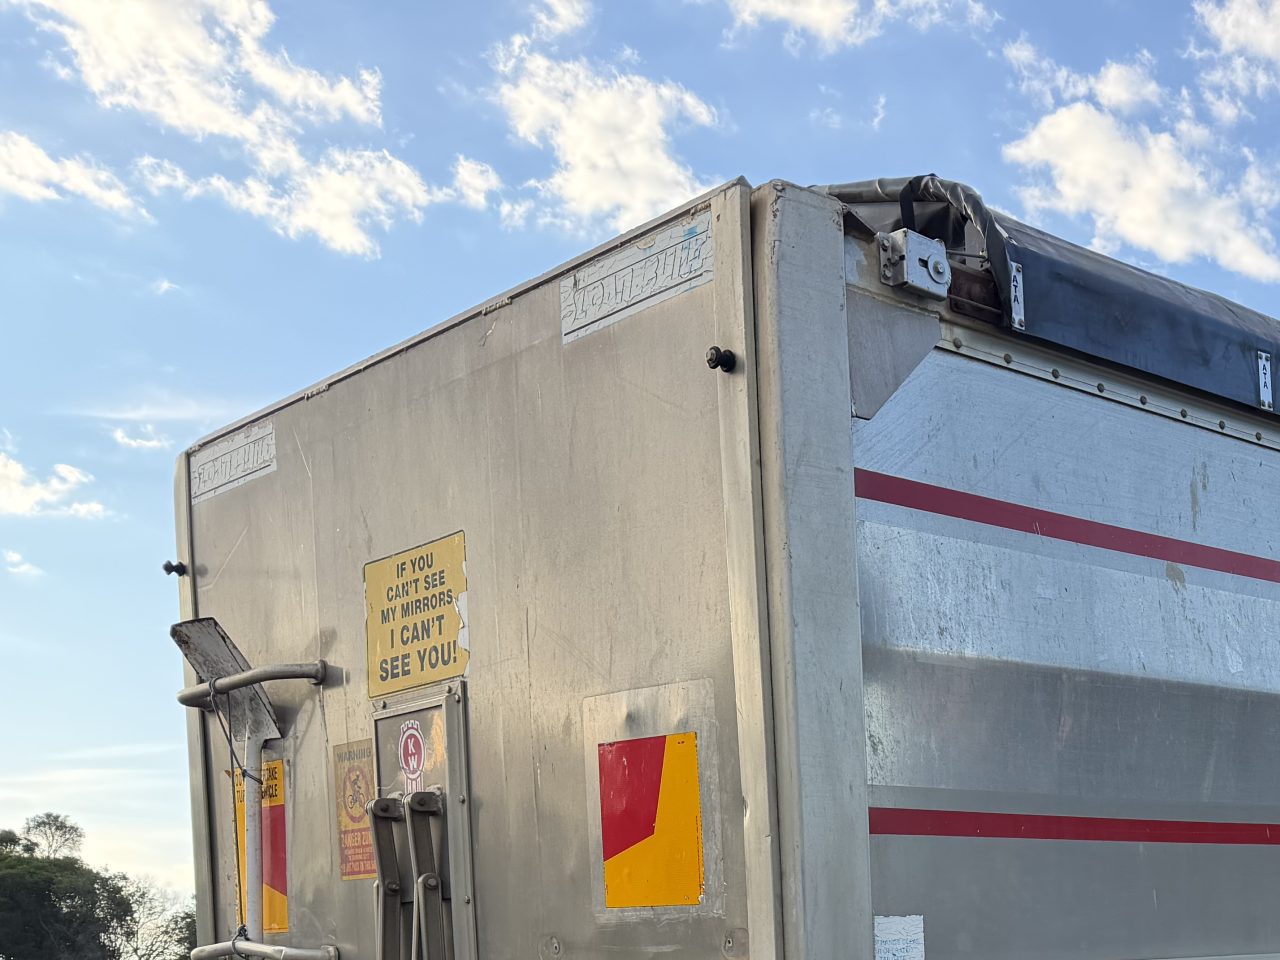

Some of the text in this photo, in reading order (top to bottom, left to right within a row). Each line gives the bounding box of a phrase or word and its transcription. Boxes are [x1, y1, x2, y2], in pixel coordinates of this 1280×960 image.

[396, 552, 434, 578] IF YOU
[386, 569, 446, 602] CAN'T SEE
[381, 588, 453, 624] MY MIRRORS
[390, 614, 444, 649] I CAN'T
[379, 640, 457, 681] SEE YOU!
